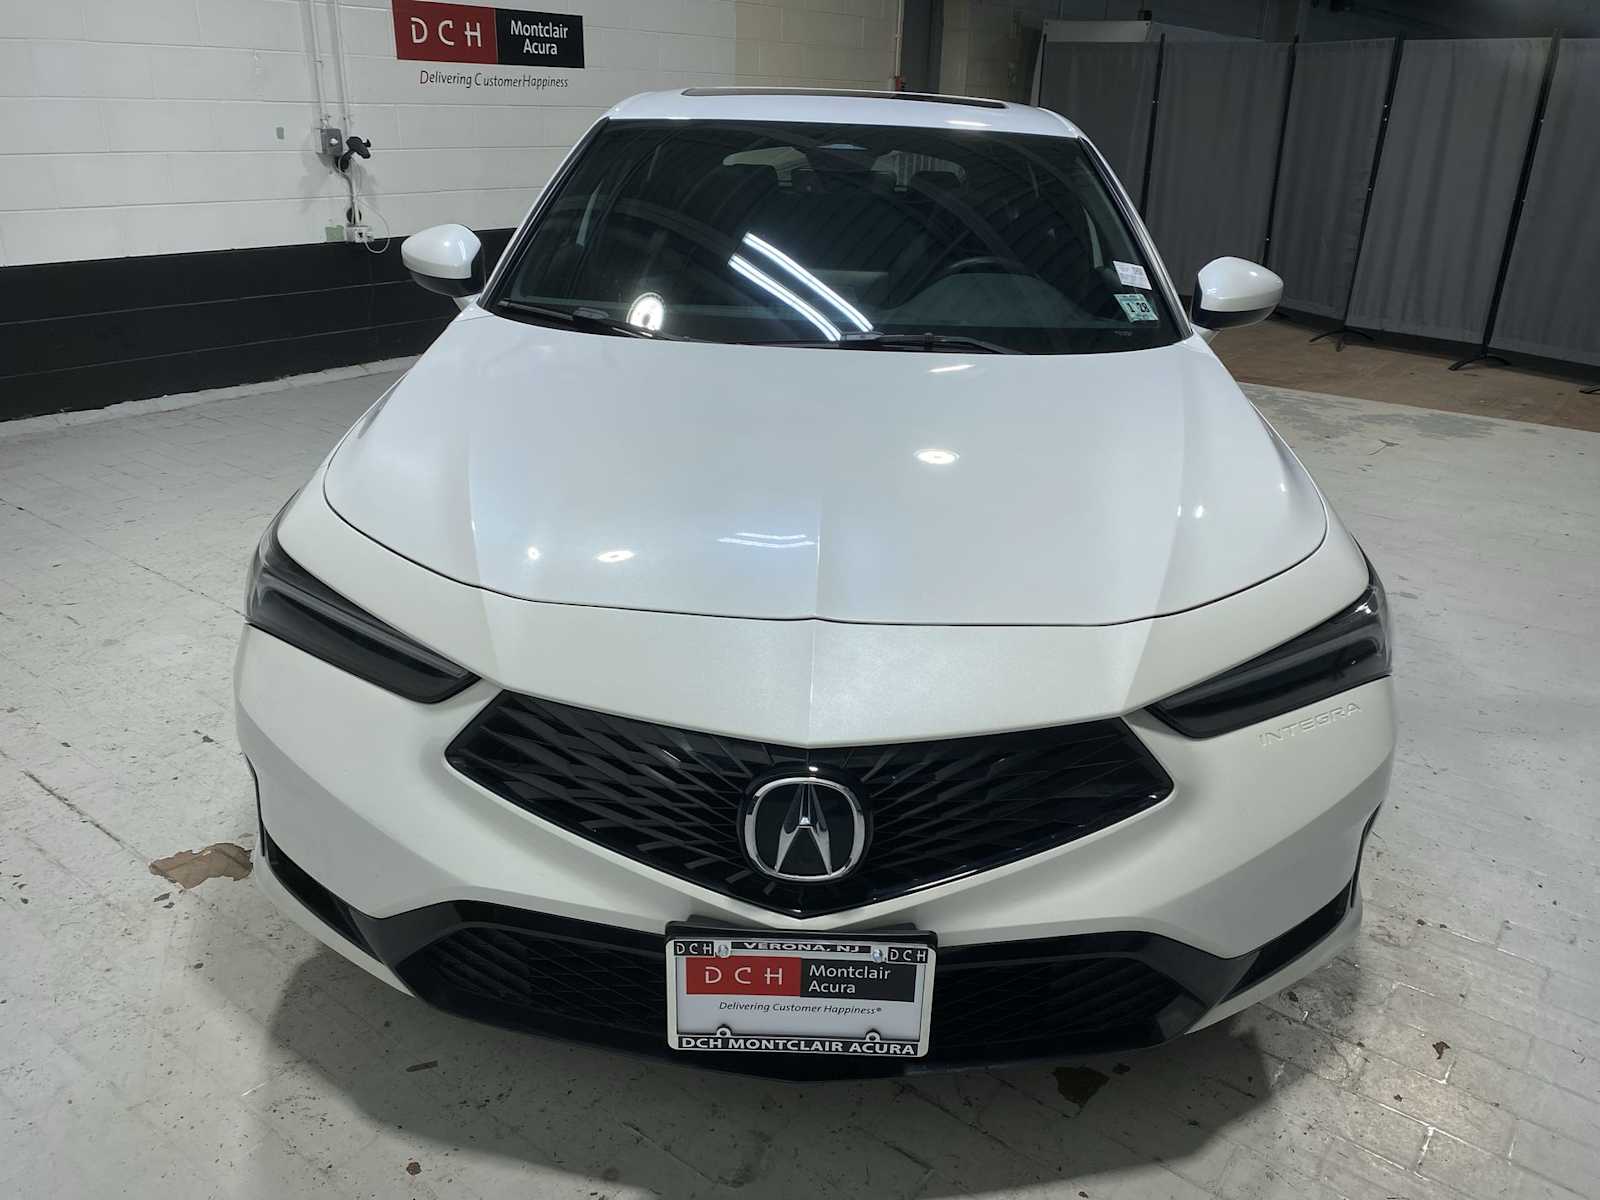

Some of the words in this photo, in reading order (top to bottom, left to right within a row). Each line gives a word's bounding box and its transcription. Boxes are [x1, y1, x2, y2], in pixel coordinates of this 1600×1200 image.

[510, 20, 569, 39] Montclair
[523, 38, 558, 55] Acura
[420, 70, 472, 89] Delivering
[1258, 702, 1361, 748] INTEGRA
[743, 942, 831, 952] VERONA,
[836, 945, 860, 953] NJ
[809, 964, 891, 980] Montclair
[808, 980, 857, 994] Acura
[719, 1001, 770, 1013] Delivering
[772, 1003, 821, 1013] Customer
[681, 1037, 723, 1049] DCH
[728, 1039, 844, 1052] MONTCLAIR
[848, 1043, 915, 1055] ACURA
